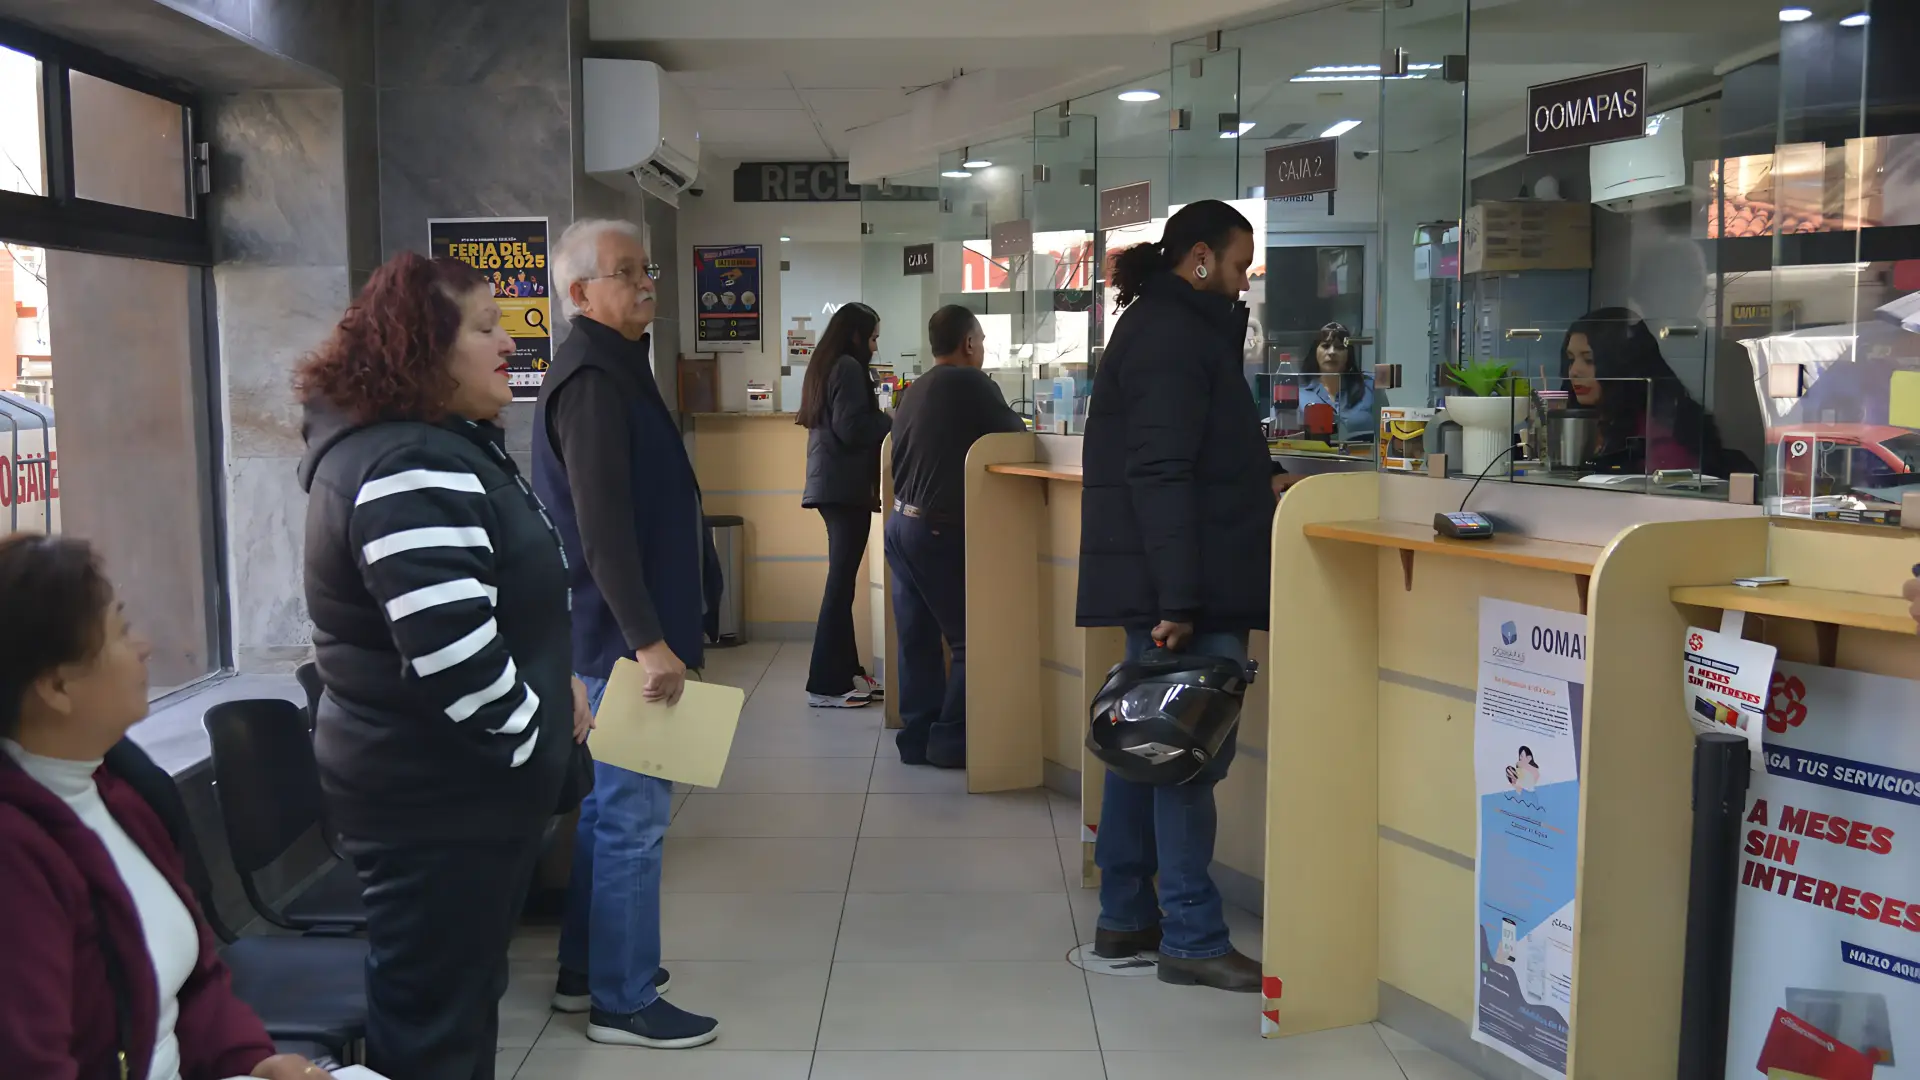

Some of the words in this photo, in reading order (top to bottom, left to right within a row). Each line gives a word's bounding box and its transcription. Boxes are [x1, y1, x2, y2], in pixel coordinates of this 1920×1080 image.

[1535, 88, 1637, 132] OOMAPAS
[1278, 157, 1311, 182] CAJA
[1314, 156, 1322, 177] 2
[449, 242, 497, 257] FERIA
[500, 242, 531, 257] DEL
[453, 255, 502, 269] PLEO
[504, 254, 545, 269] 2025
[1531, 625, 1586, 661] OOMA
[1688, 665, 1695, 675] A
[1698, 668, 1731, 685] MESES
[1688, 675, 1704, 687] SIN
[1705, 679, 1761, 705] INTERESES
[1797, 758, 1829, 778] TUS
[1832, 766, 1920, 798] SERVICIOS
[1746, 798, 1768, 827] A
[1779, 804, 1895, 855] MESES
[1744, 829, 1801, 866] SIN
[1741, 859, 1920, 933] INTERESES
[1849, 948, 1890, 970] HAZLO
